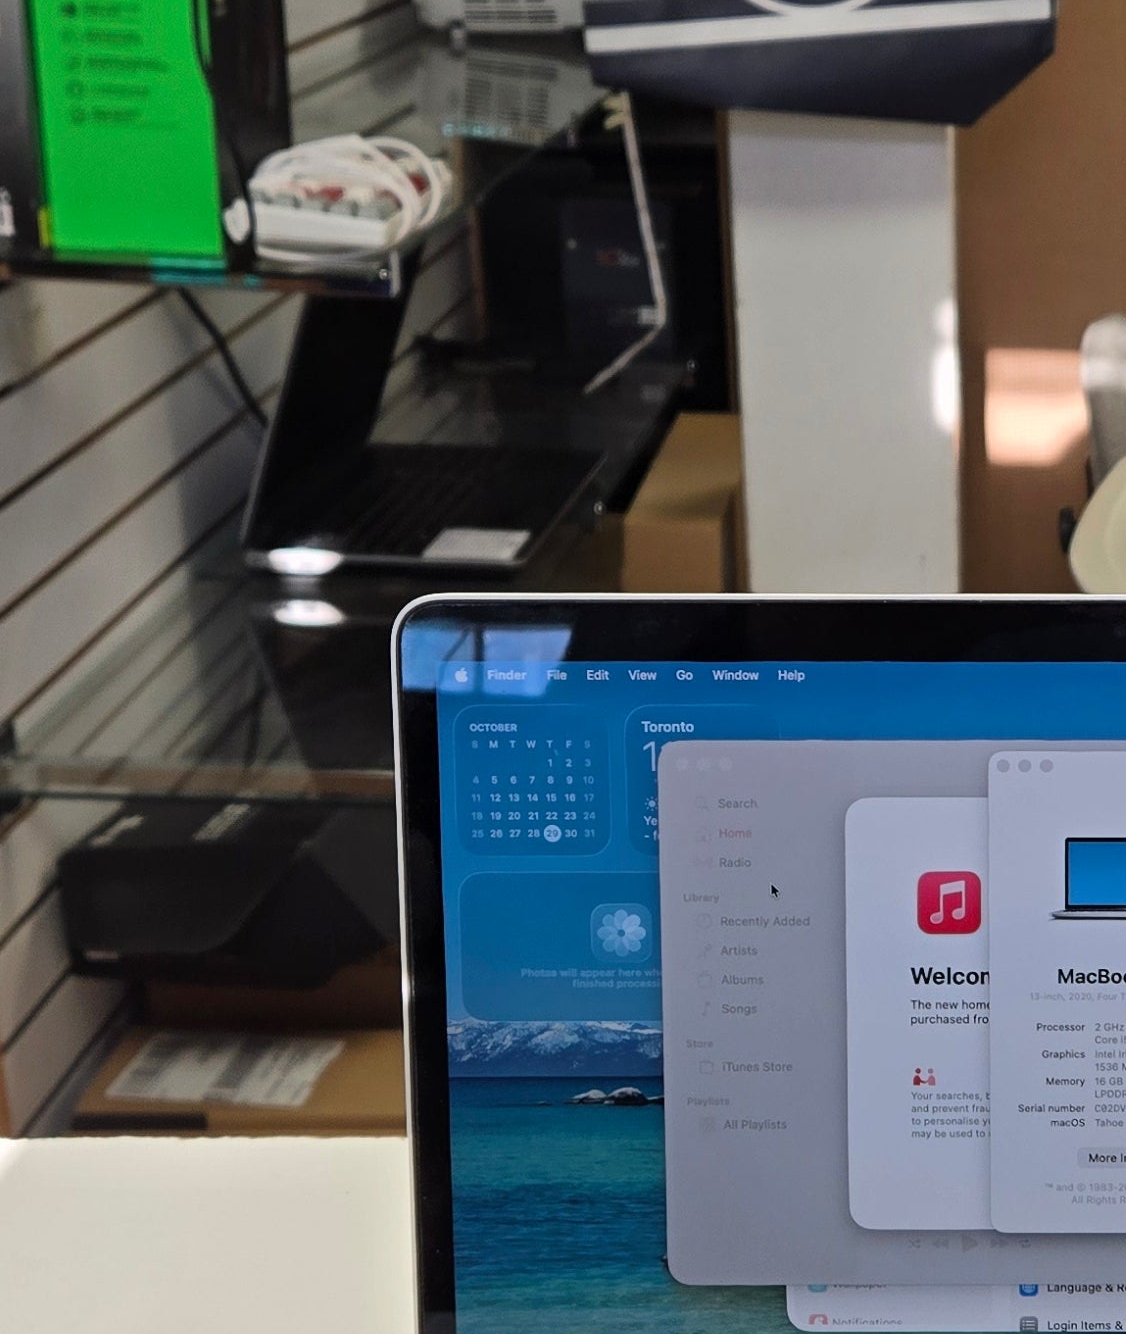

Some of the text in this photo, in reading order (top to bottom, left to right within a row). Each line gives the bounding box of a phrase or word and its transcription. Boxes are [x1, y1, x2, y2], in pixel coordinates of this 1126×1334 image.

[487, 670, 805, 683] Finder File Edit View Go Window Help
[469, 723, 517, 732] OCTOBER
[641, 721, 694, 733] Toronto
[718, 799, 757, 809] Search
[719, 828, 752, 839] Home
[719, 858, 751, 868] Radio
[683, 893, 720, 904] Library
[720, 916, 810, 928] Recently Added
[720, 946, 758, 956] Artists
[721, 975, 764, 985] Albums
[721, 1004, 757, 1016] Songs
[911, 1000, 958, 1010] The new
[910, 1015, 969, 1026] purchased
[1036, 1023, 1085, 1032] Processor
[1095, 1023, 1101, 1032] 2
[1104, 1023, 1124, 1032] GHz
[686, 1039, 713, 1048] Store
[1095, 1036, 1117, 1044] Core
[1042, 1051, 1085, 1060] Graphics
[1095, 1051, 1116, 1059] Intel
[722, 1062, 793, 1072] iTunes Store
[1095, 1063, 1119, 1071] 1536
[1046, 1078, 1085, 1087] Memory
[1095, 1078, 1106, 1086] 16
[1109, 1077, 1123, 1086] GB
[911, 1092, 983, 1101] Your searches,
[687, 1097, 730, 1108] Playlists
[911, 1105, 929, 1113] and
[932, 1106, 969, 1114] prevent
[1018, 1104, 1045, 1113] Serial
[1048, 1104, 1085, 1113] number
[723, 1120, 787, 1131] All Playlists
[911, 1117, 979, 1127] to personalise
[1050, 1119, 1085, 1127] macOS
[1095, 1119, 1124, 1127] Tahoe
[911, 1130, 986, 1139] may be used to
[1088, 1153, 1117, 1163] More
[1071, 1196, 1083, 1204] All
[1086, 1196, 1116, 1206] Rights
[1047, 1283, 1102, 1294] Language
[1105, 1283, 1114, 1293] &
[1047, 1320, 1078, 1332] Login
[1080, 1320, 1111, 1331] Items
[1114, 1321, 1123, 1331] &
